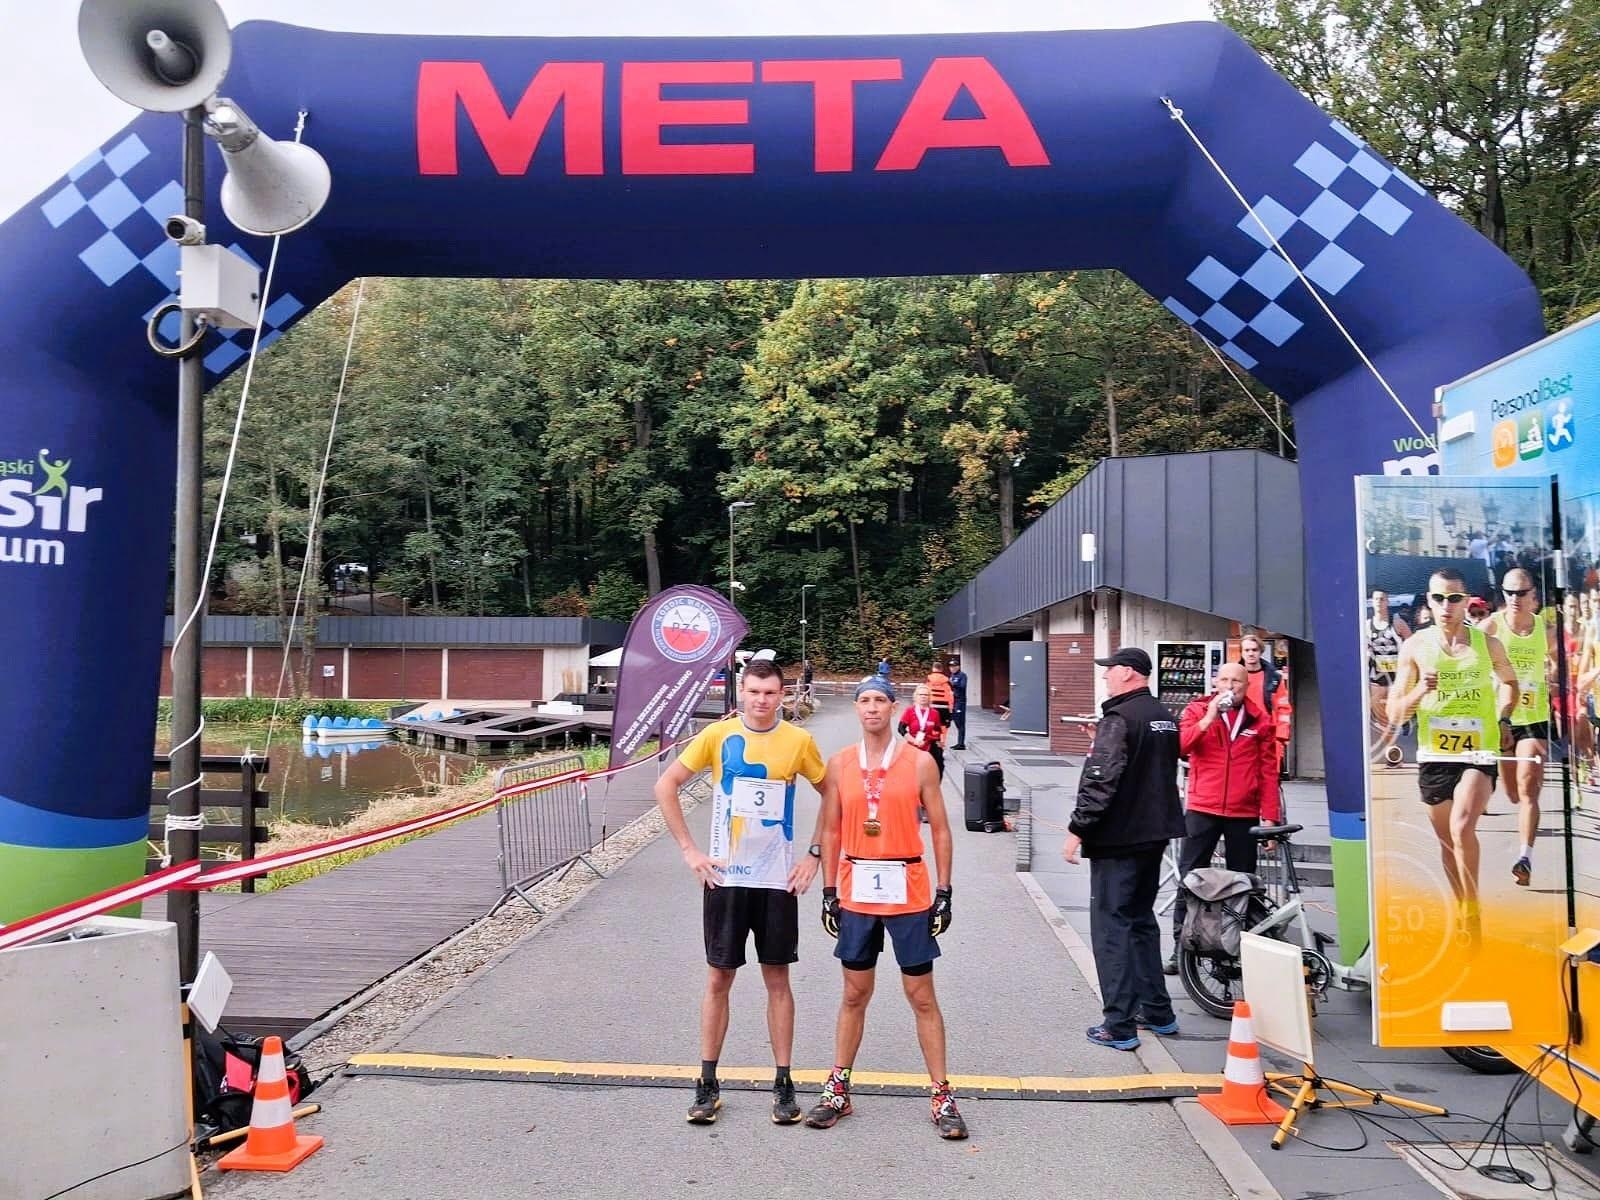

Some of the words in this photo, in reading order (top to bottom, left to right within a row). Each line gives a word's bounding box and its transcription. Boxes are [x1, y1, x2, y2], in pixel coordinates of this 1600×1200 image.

[416, 56, 1051, 176] META
[646, 699, 669, 725] NORDIC
[666, 670, 693, 700] WALKING
[616, 721, 640, 749] POLSKIE
[1439, 733, 1474, 751] 274
[754, 791, 765, 806] 3
[872, 873, 883, 890] 1
[1387, 904, 1424, 931] 50
